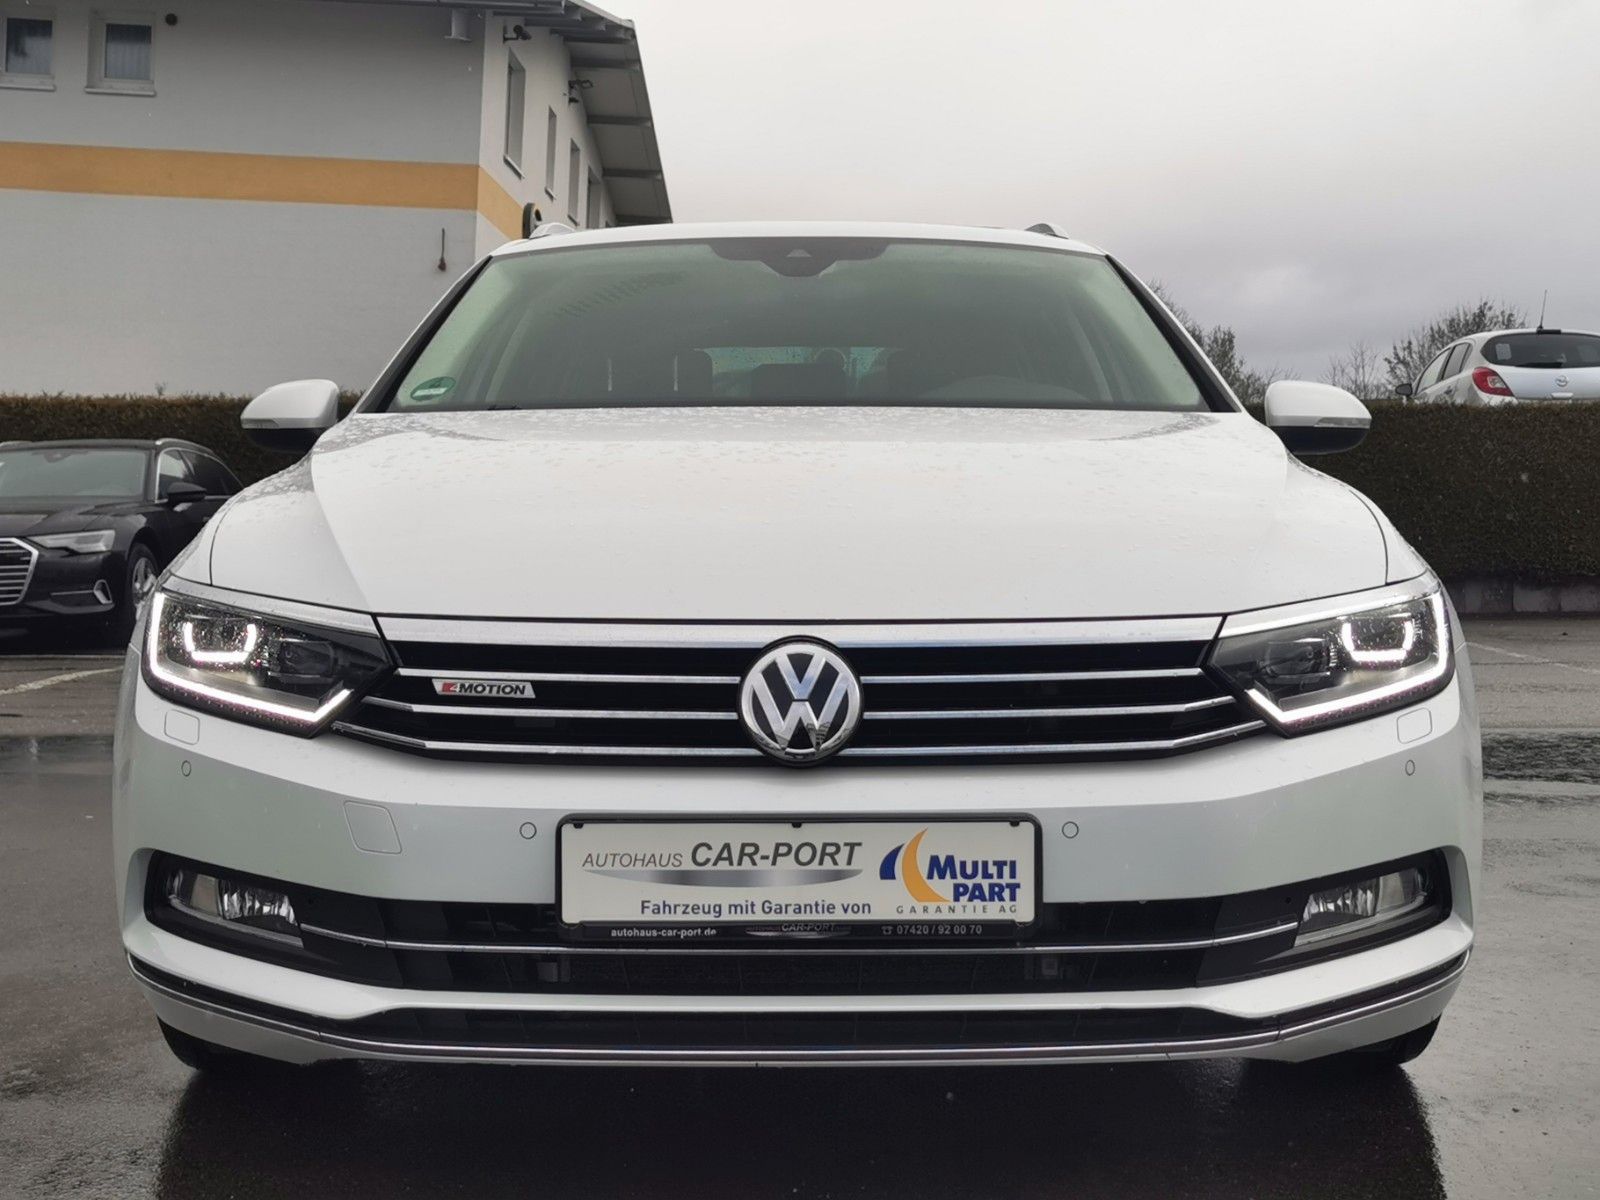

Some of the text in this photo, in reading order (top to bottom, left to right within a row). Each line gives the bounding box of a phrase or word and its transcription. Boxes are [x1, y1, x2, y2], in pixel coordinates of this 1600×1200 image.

[442, 682, 526, 695] 4MOTION
[745, 648, 855, 757] VW
[582, 842, 862, 868] AUTOHAUS CAR-PORT
[927, 855, 1017, 880] MULTI
[953, 883, 1021, 902] PART
[640, 900, 872, 918] Fahrzeug mit Garantie von
[896, 904, 1017, 914] GARANTIE AG
[611, 928, 717, 939] autohaus-car-port.de
[897, 925, 929, 935] 07420
[938, 925, 951, 935] 92
[953, 925, 967, 935] 00
[969, 925, 983, 935] 70
